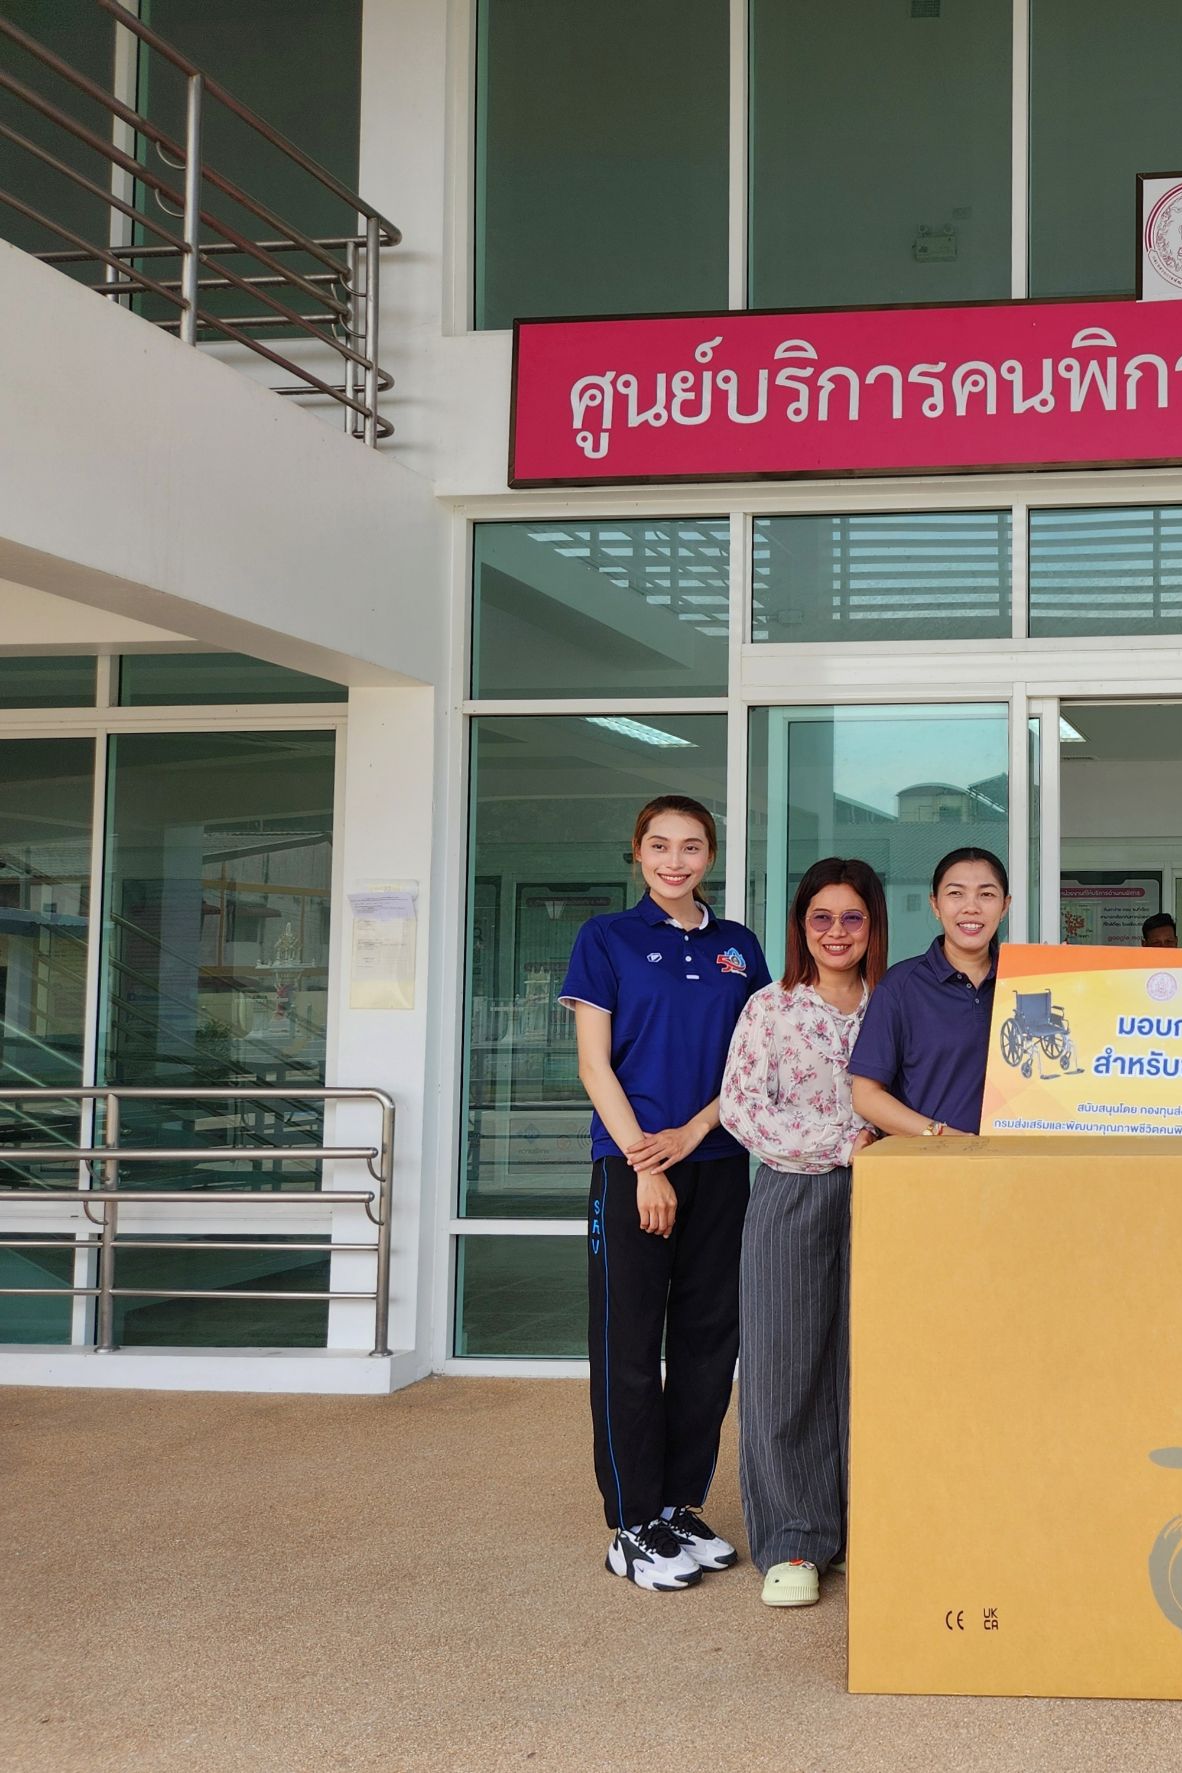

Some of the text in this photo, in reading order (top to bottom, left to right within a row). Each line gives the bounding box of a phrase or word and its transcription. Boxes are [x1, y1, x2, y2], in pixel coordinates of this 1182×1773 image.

[1077, 1102, 1138, 1117] สนับสนุนโดย
[945, 1607, 999, 1631] CE UK
[983, 1619, 999, 1631] CA
